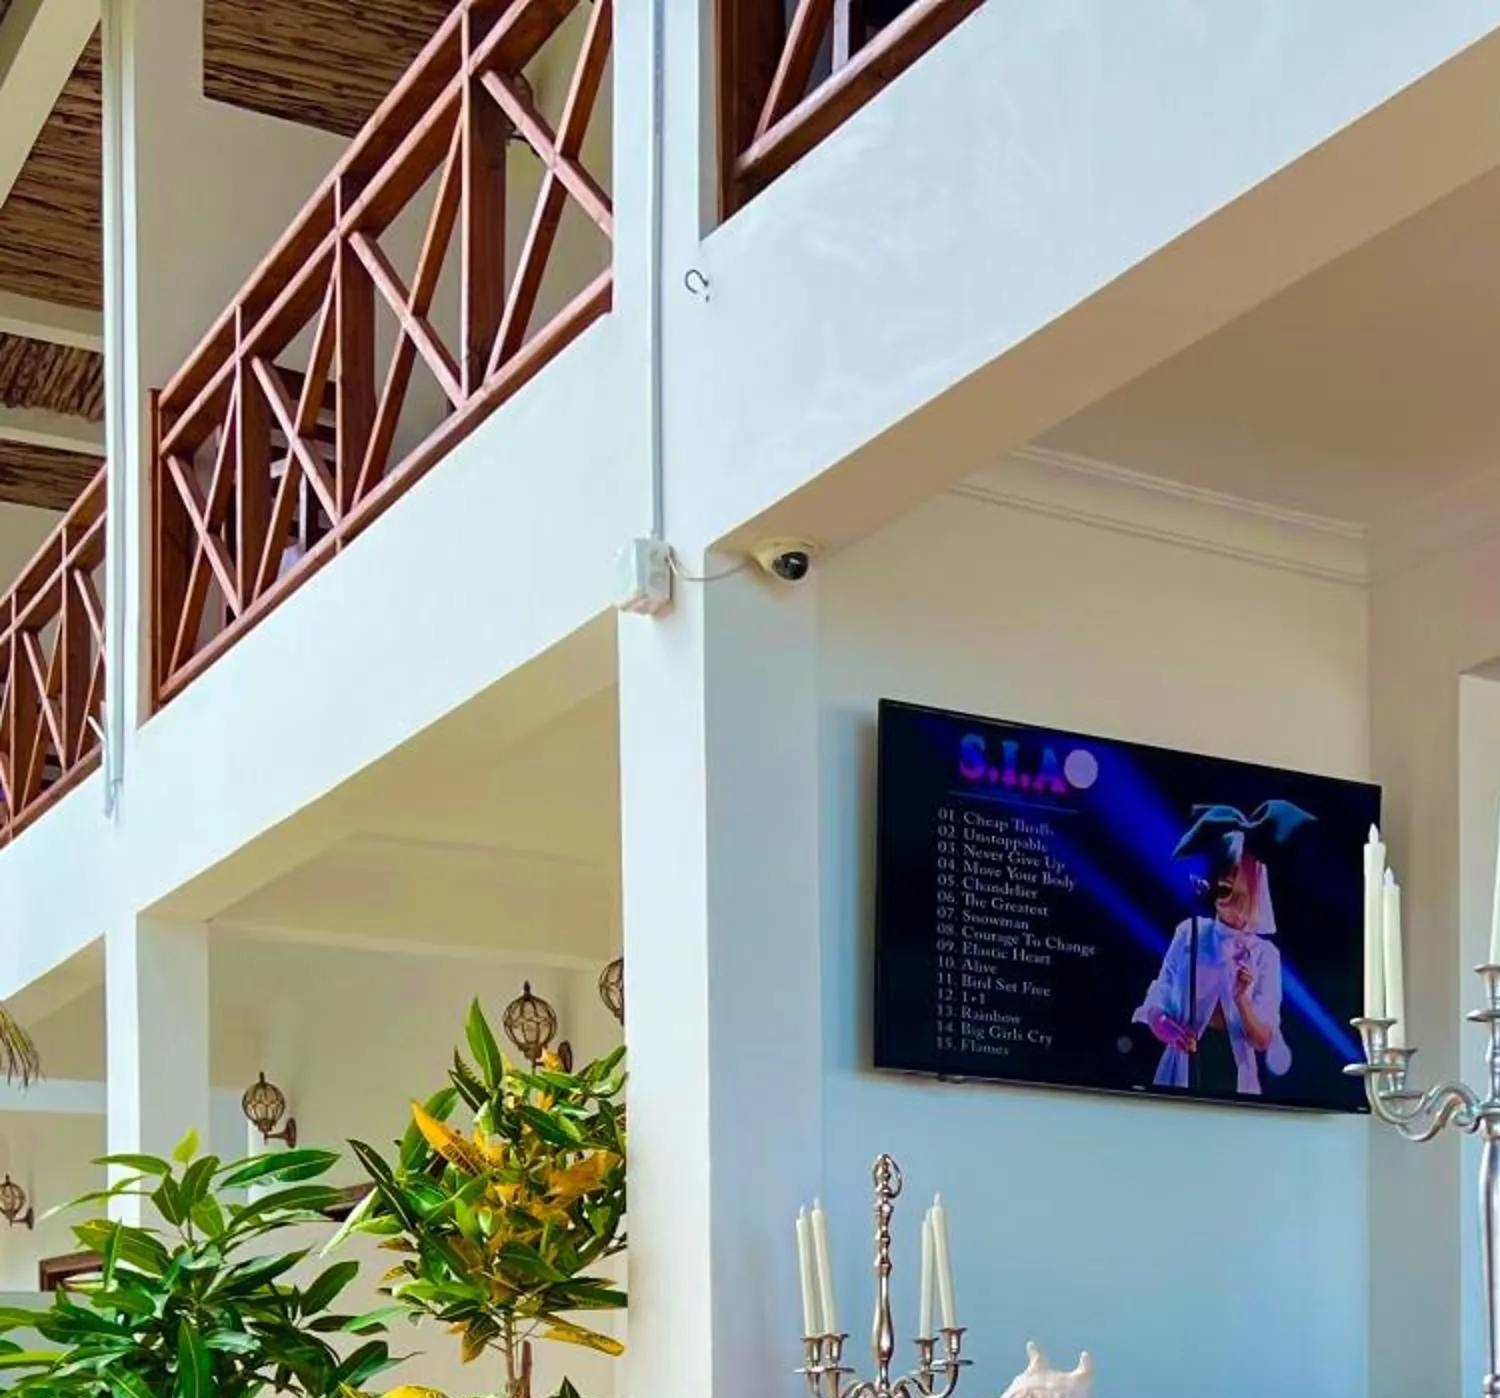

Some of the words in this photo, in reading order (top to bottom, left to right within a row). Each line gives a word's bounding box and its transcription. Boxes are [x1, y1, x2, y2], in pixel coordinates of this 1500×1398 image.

[963, 811, 1009, 832] Cheap
[963, 828, 1048, 851] Unstoppable
[963, 844, 1003, 861] Never
[1007, 850, 1040, 867] Give
[1045, 855, 1065, 874] Up
[962, 876, 1039, 899] Chandelier
[963, 860, 1002, 877] Move
[1006, 866, 1038, 883] Your
[1042, 872, 1075, 892] Body
[961, 892, 987, 908] The
[991, 897, 1049, 917] Greatest
[962, 909, 1029, 930] Snowman
[961, 926, 1019, 947] Courage
[1022, 932, 1041, 948] To
[1045, 936, 1096, 957] Change
[962, 942, 1009, 959] Elastic
[1012, 948, 1051, 965] Heart
[962, 958, 998, 975] Alive
[961, 973, 992, 989] Bird
[995, 978, 1017, 993] Set
[961, 1006, 1022, 1024] Rainbow
[961, 1022, 985, 1040] Big
[988, 1025, 1024, 1041] Girls
[1027, 1029, 1052, 1048] Cry
[961, 1038, 1009, 1056] Flames
